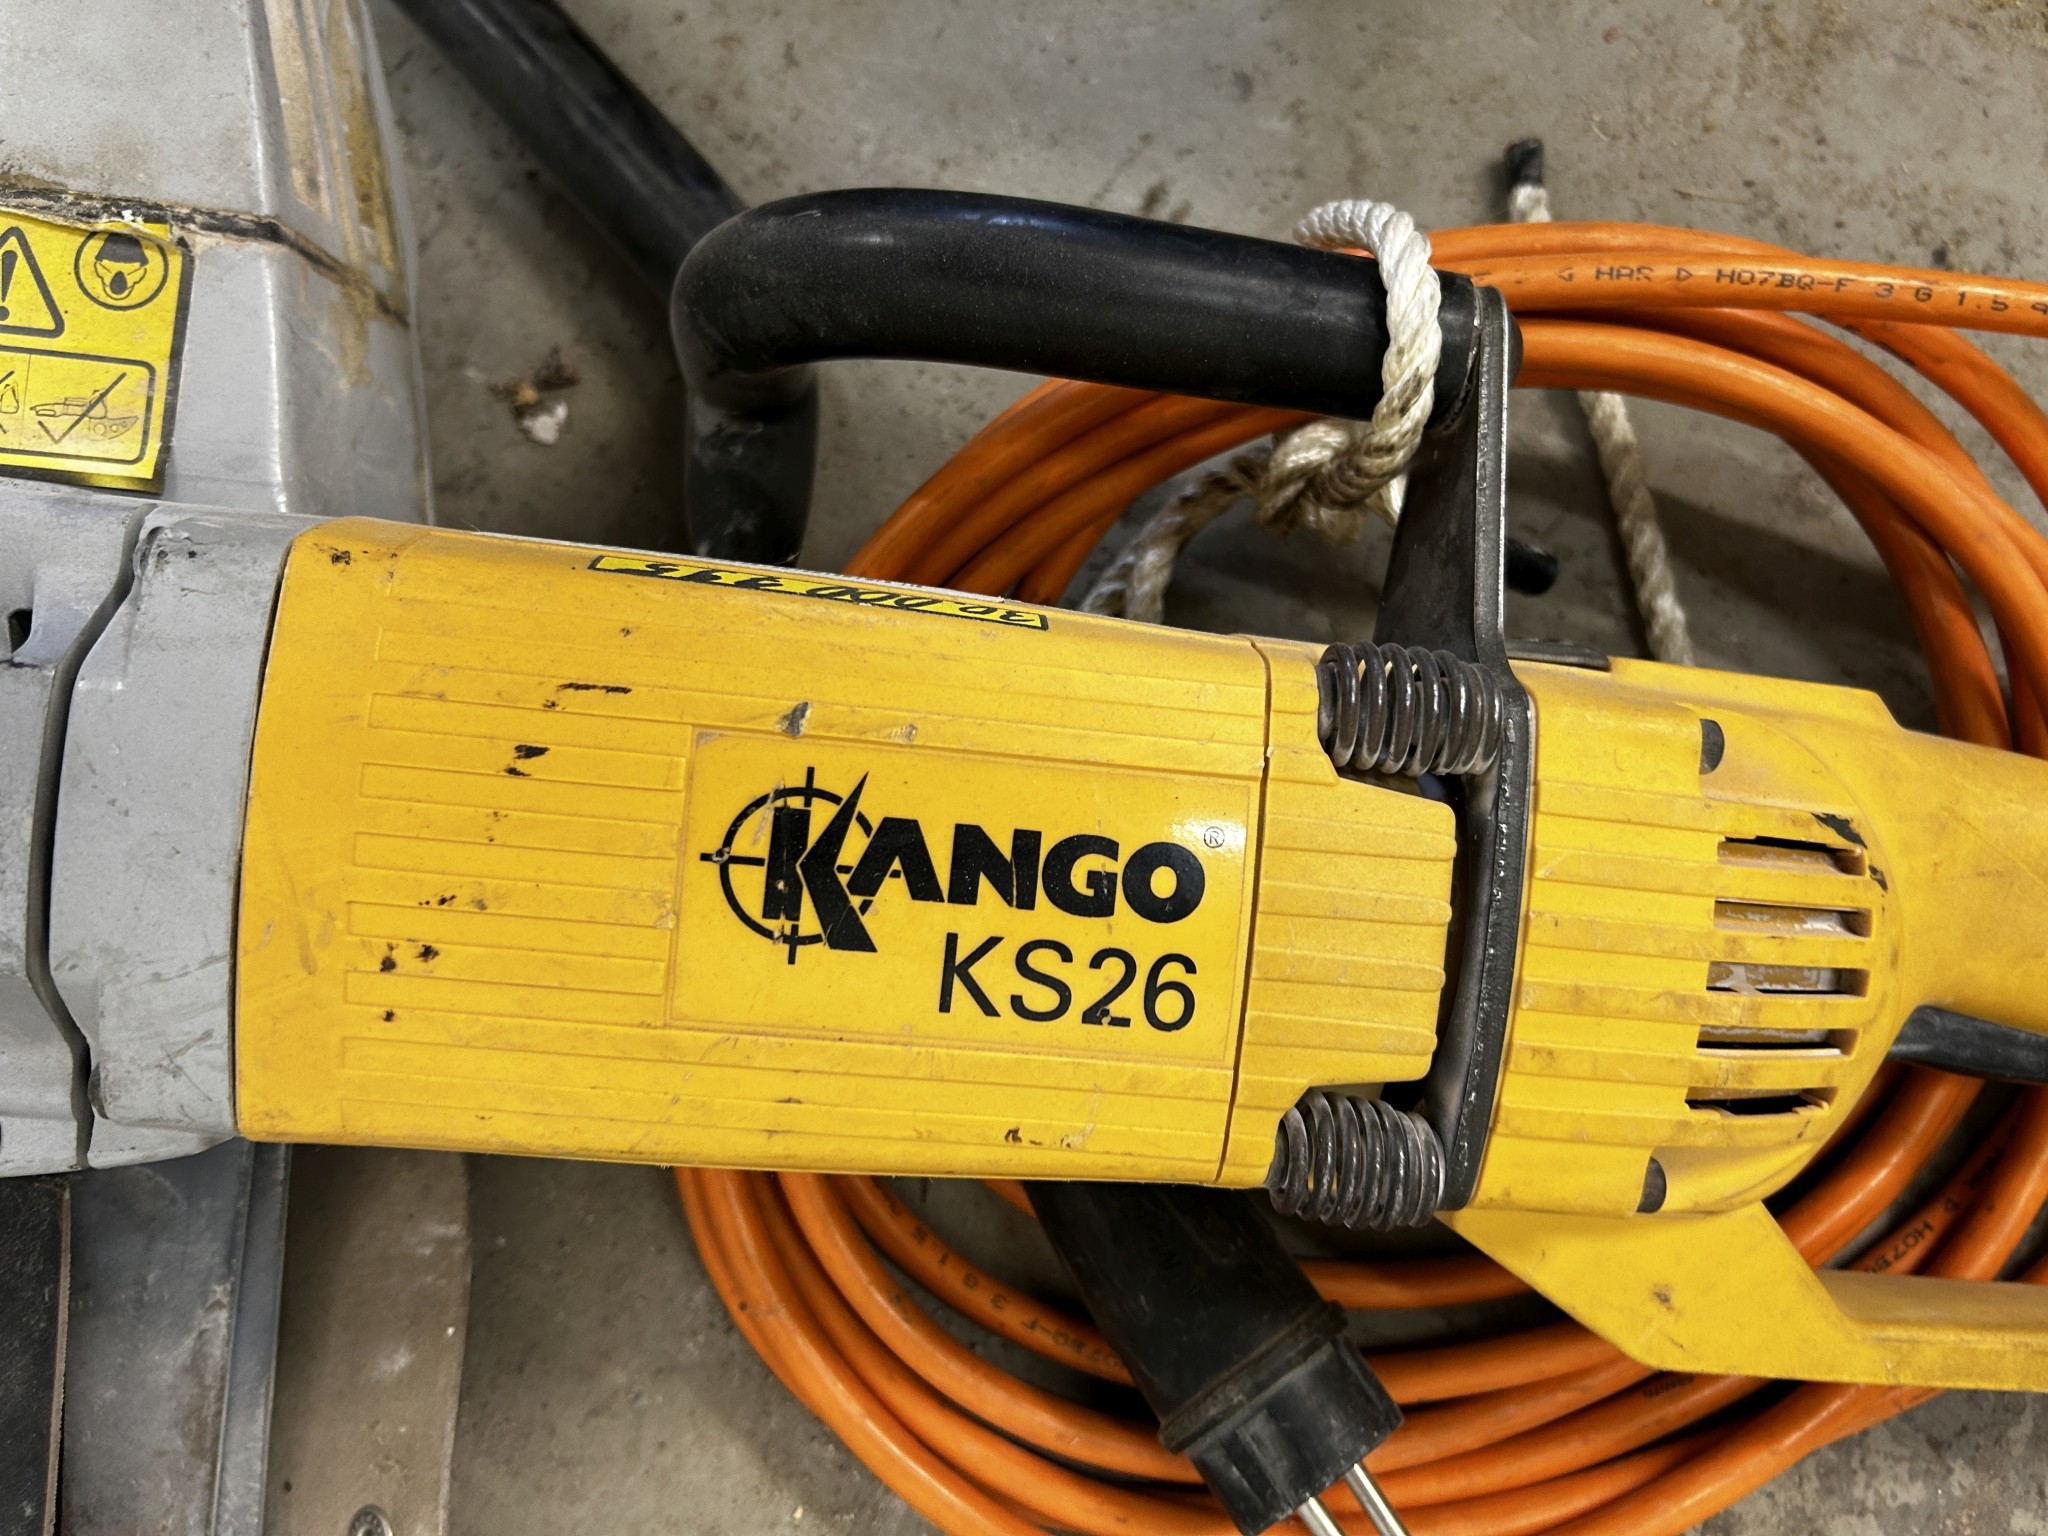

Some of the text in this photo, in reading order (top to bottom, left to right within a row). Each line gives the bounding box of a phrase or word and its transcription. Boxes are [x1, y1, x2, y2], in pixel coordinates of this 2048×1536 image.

[1874, 282, 1894, 299] 3
[1914, 286, 1933, 302] G
[1958, 291, 2009, 312] 1.5
[762, 771, 1205, 952] KANGO
[938, 932, 1198, 1032] KS26
